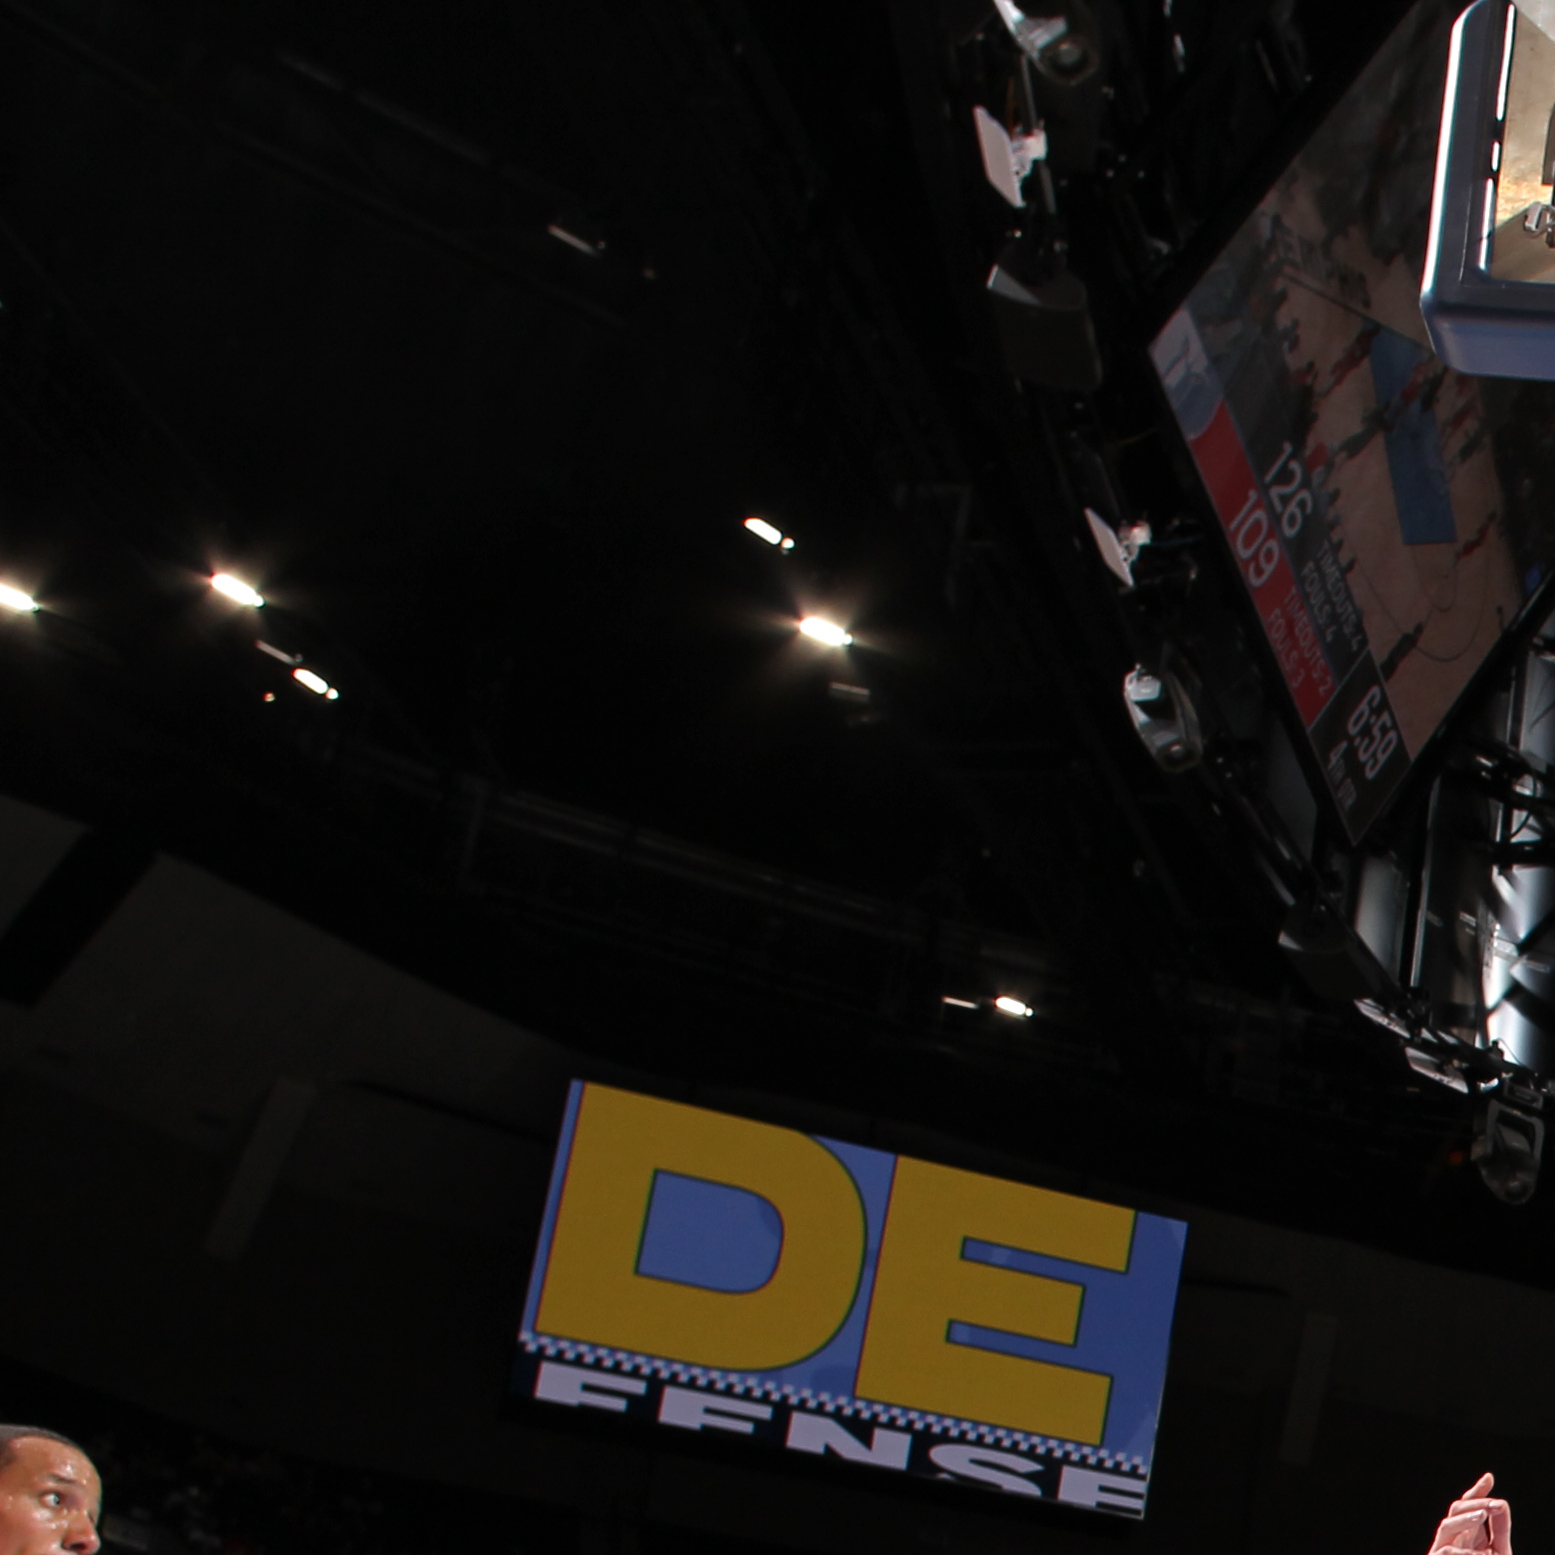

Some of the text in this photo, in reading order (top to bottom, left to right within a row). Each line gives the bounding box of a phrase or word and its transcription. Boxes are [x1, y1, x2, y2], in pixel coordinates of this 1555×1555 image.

[1263, 441, 1312, 538] 126
[1227, 490, 1280, 589] 109
[1347, 685, 1399, 781] 6:59
[534, 1082, 1137, 1445] DE
